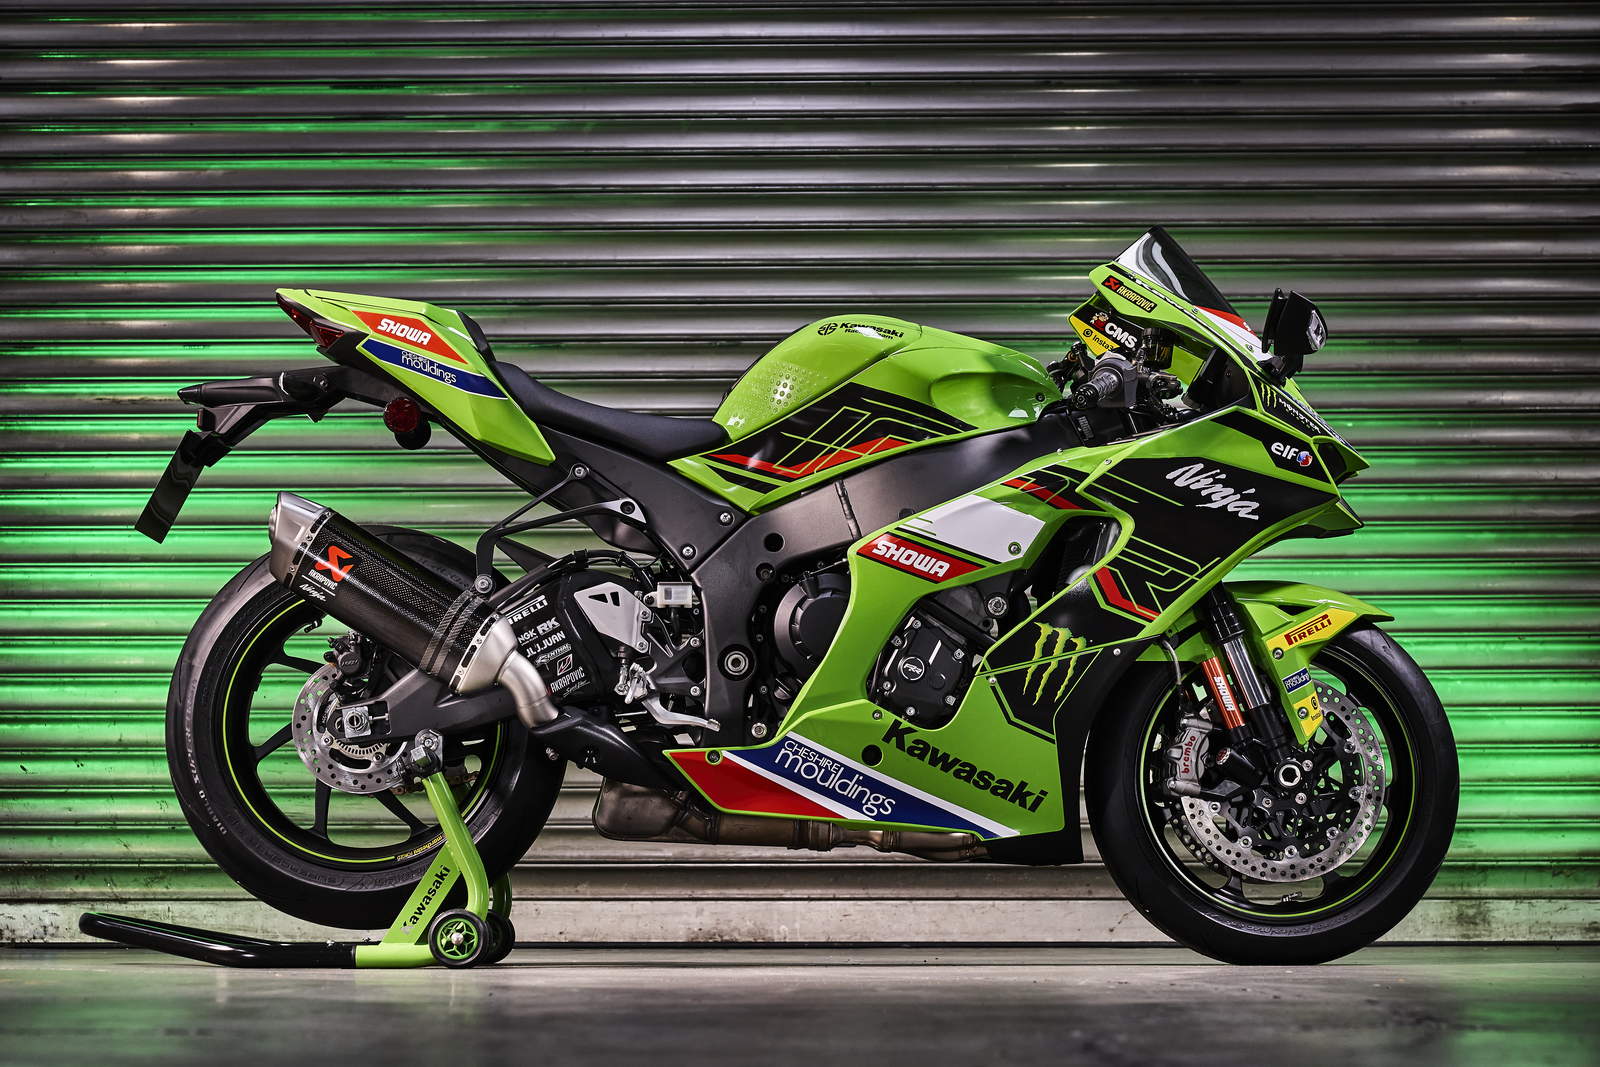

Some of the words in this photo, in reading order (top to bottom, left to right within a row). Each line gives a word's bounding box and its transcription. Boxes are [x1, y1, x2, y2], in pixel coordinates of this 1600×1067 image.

[376, 317, 432, 346] SHOWA
[1104, 322, 1138, 350] CMS
[401, 355, 457, 384] mouldings
[1270, 441, 1300, 460] elf
[1165, 462, 1260, 521] Ninja
[871, 540, 951, 577] SHOWA
[299, 583, 327, 602] Ninja
[518, 628, 537, 644] NGK
[536, 616, 561, 636] RK
[1284, 613, 1332, 647] PIRELLI
[1213, 675, 1236, 712] SHOWA
[784, 740, 841, 774] CHESHIRE
[881, 718, 1049, 813] Kawasaki
[1181, 735, 1196, 774] brembo
[774, 747, 896, 817] mouldings
[402, 864, 452, 930] awasaki
